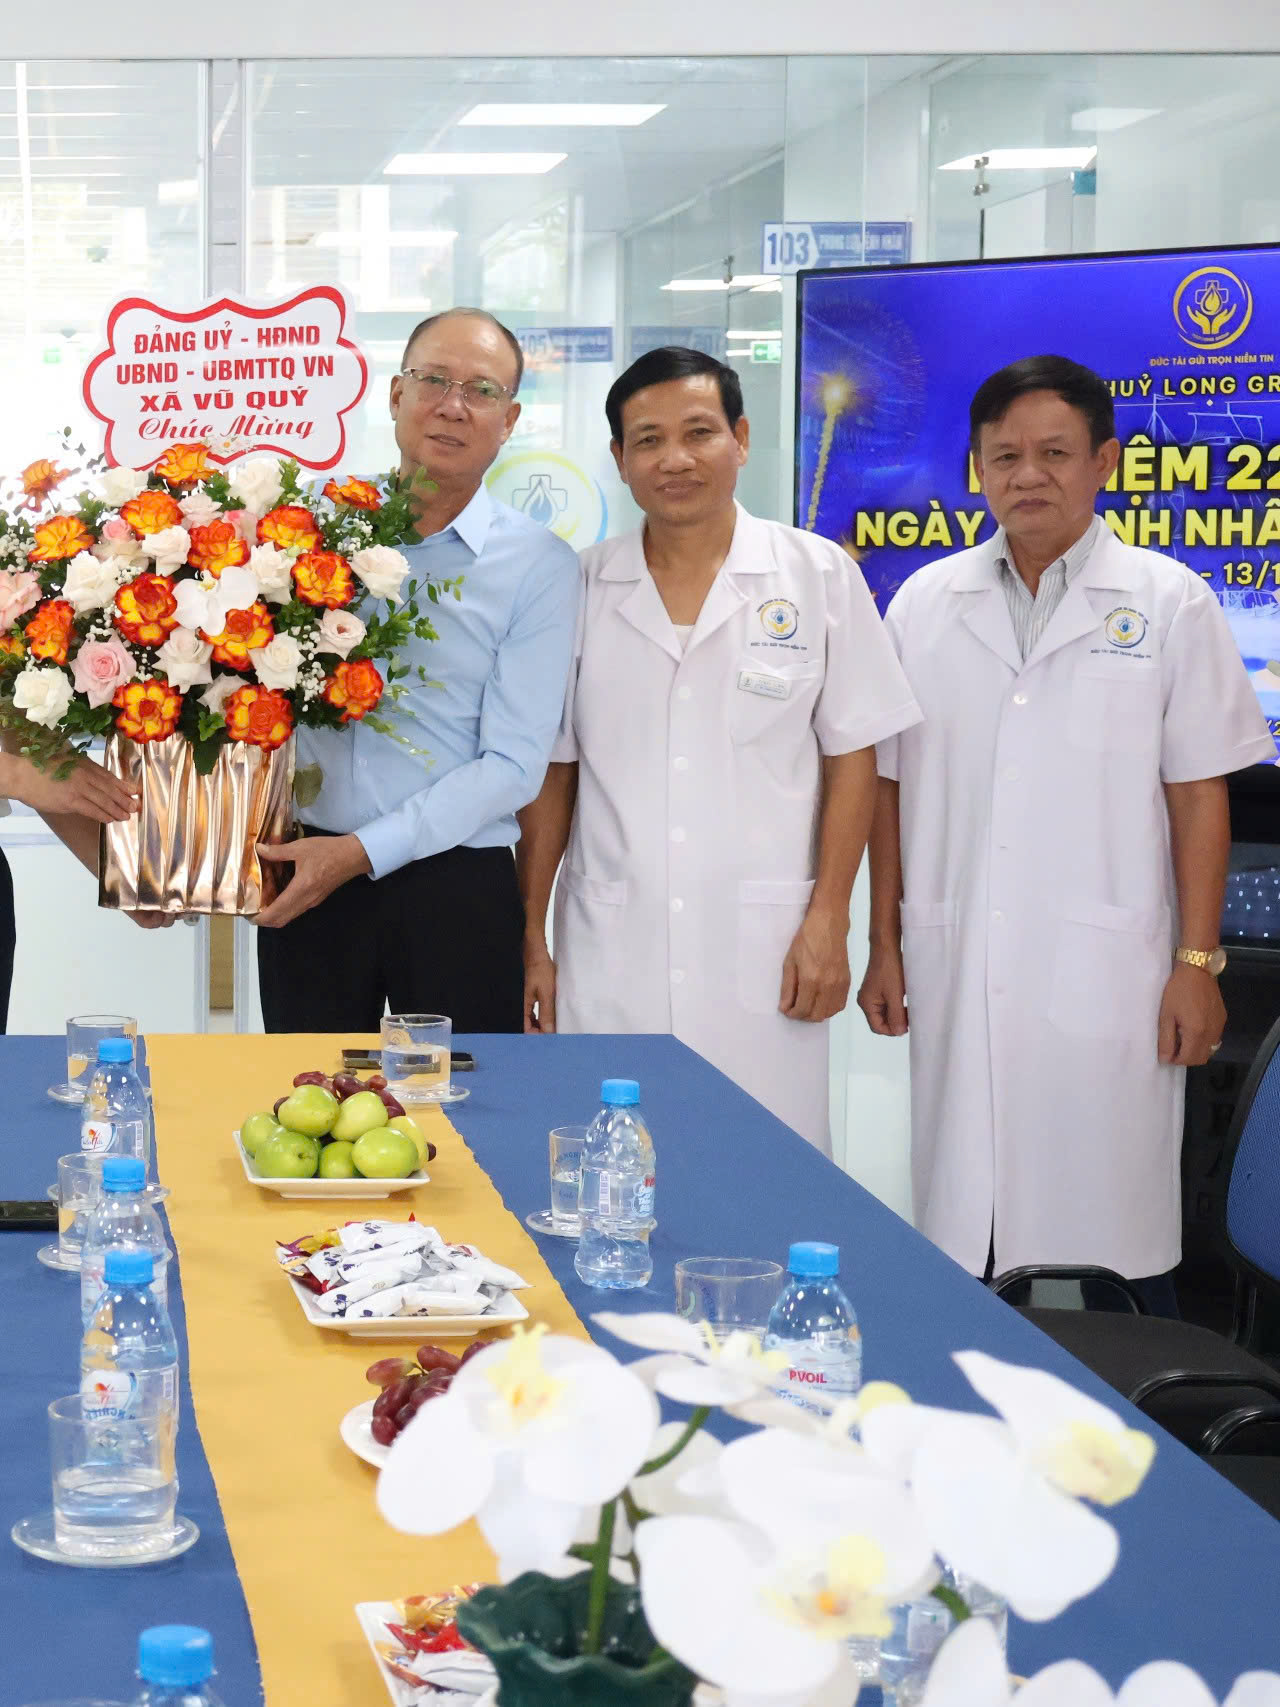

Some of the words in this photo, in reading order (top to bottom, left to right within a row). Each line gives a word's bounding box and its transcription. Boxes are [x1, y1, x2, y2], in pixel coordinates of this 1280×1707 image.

[767, 231, 810, 266] 103
[133, 324, 197, 354] ĐẢNG
[204, 320, 234, 351] UỶ
[257, 325, 320, 349] HĐND
[116, 362, 178, 385] UBND
[203, 356, 295, 382] UBMTTQ
[304, 355, 334, 377] VN
[1207, 355, 1232, 367] TRỌN
[1259, 354, 1274, 363] TIN
[139, 391, 183, 412] XÃ
[194, 389, 232, 411] VŨ
[246, 385, 309, 410] QUÝ
[1104, 373, 1152, 397] HUỶ
[1164, 376, 1236, 395] LONG
[138, 418, 215, 440] Chúc
[219, 414, 316, 440] Mừng
[856, 500, 986, 547] NGÀY
[789, 1368, 828, 1384] PVOIL
